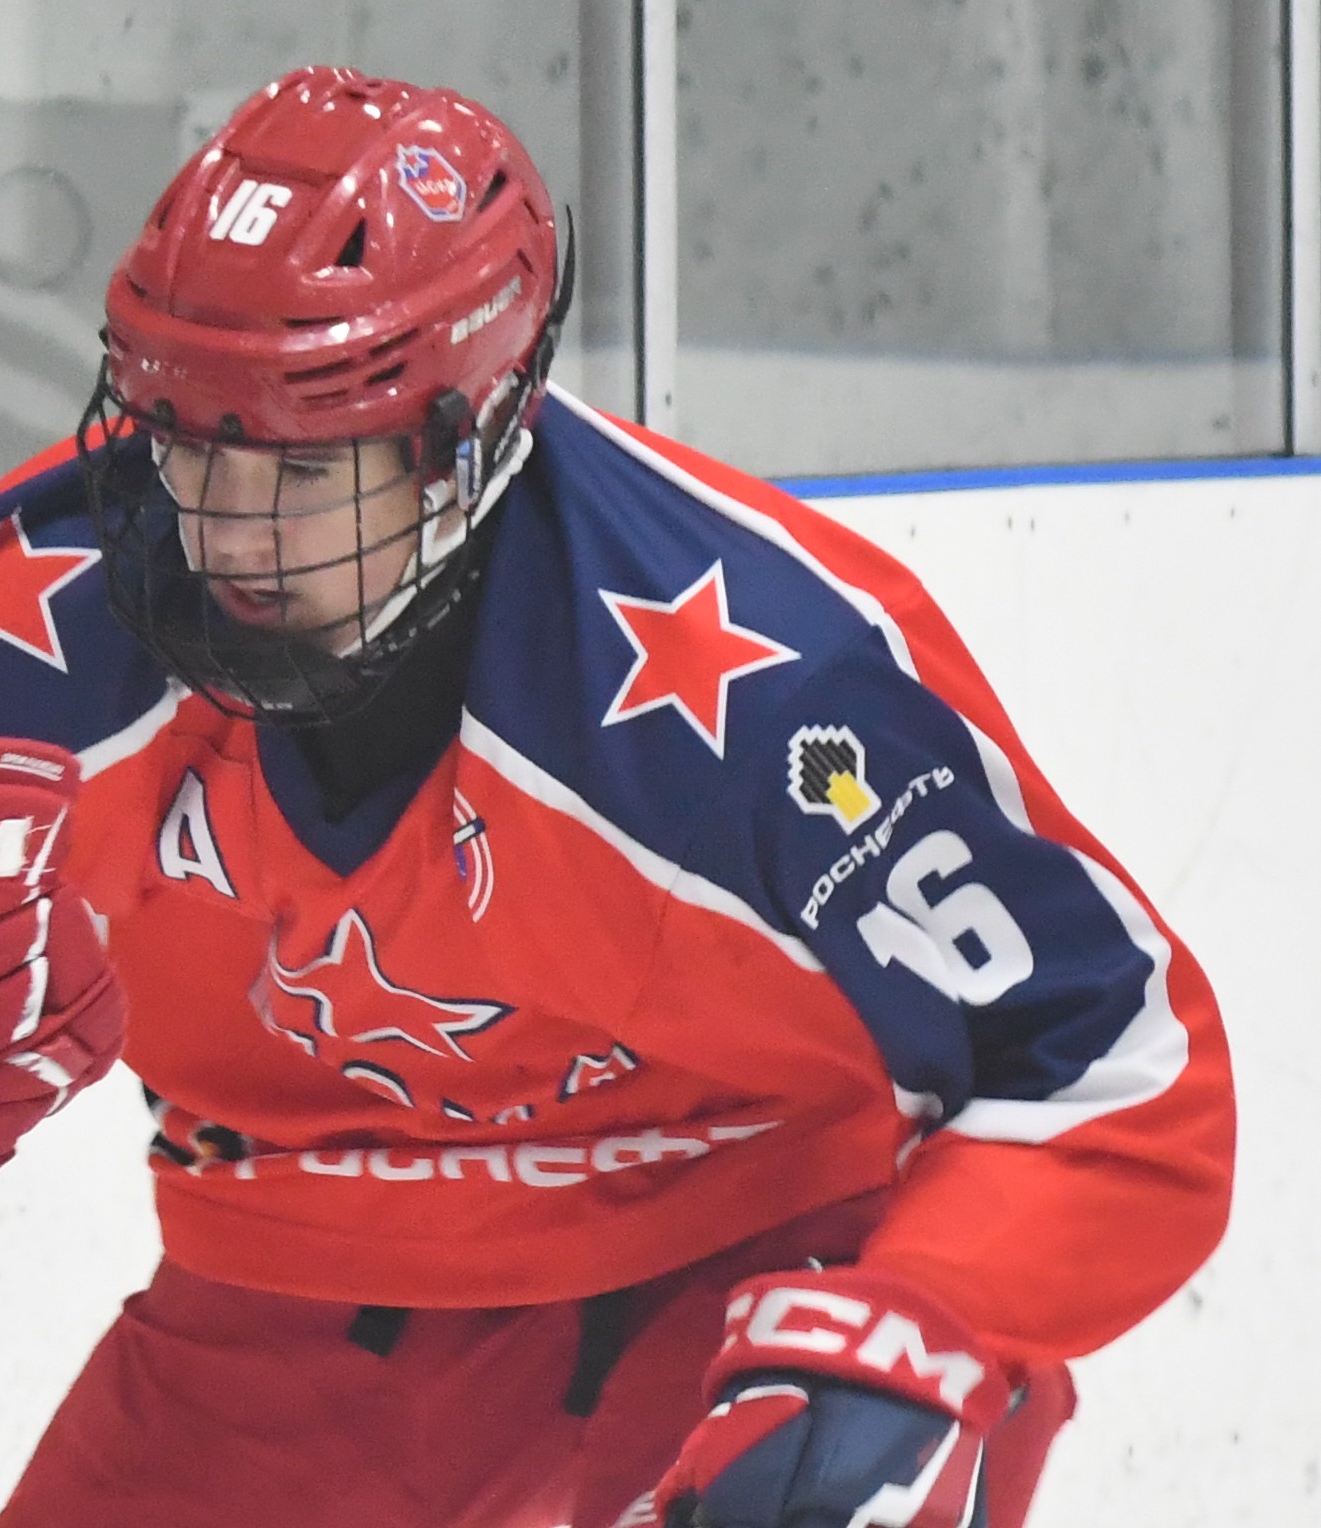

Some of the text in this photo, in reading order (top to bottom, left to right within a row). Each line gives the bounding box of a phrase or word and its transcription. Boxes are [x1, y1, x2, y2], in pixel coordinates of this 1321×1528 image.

[210, 179, 292, 246] 16
[158, 766, 240, 900] A
[857, 829, 1034, 1007] 16
